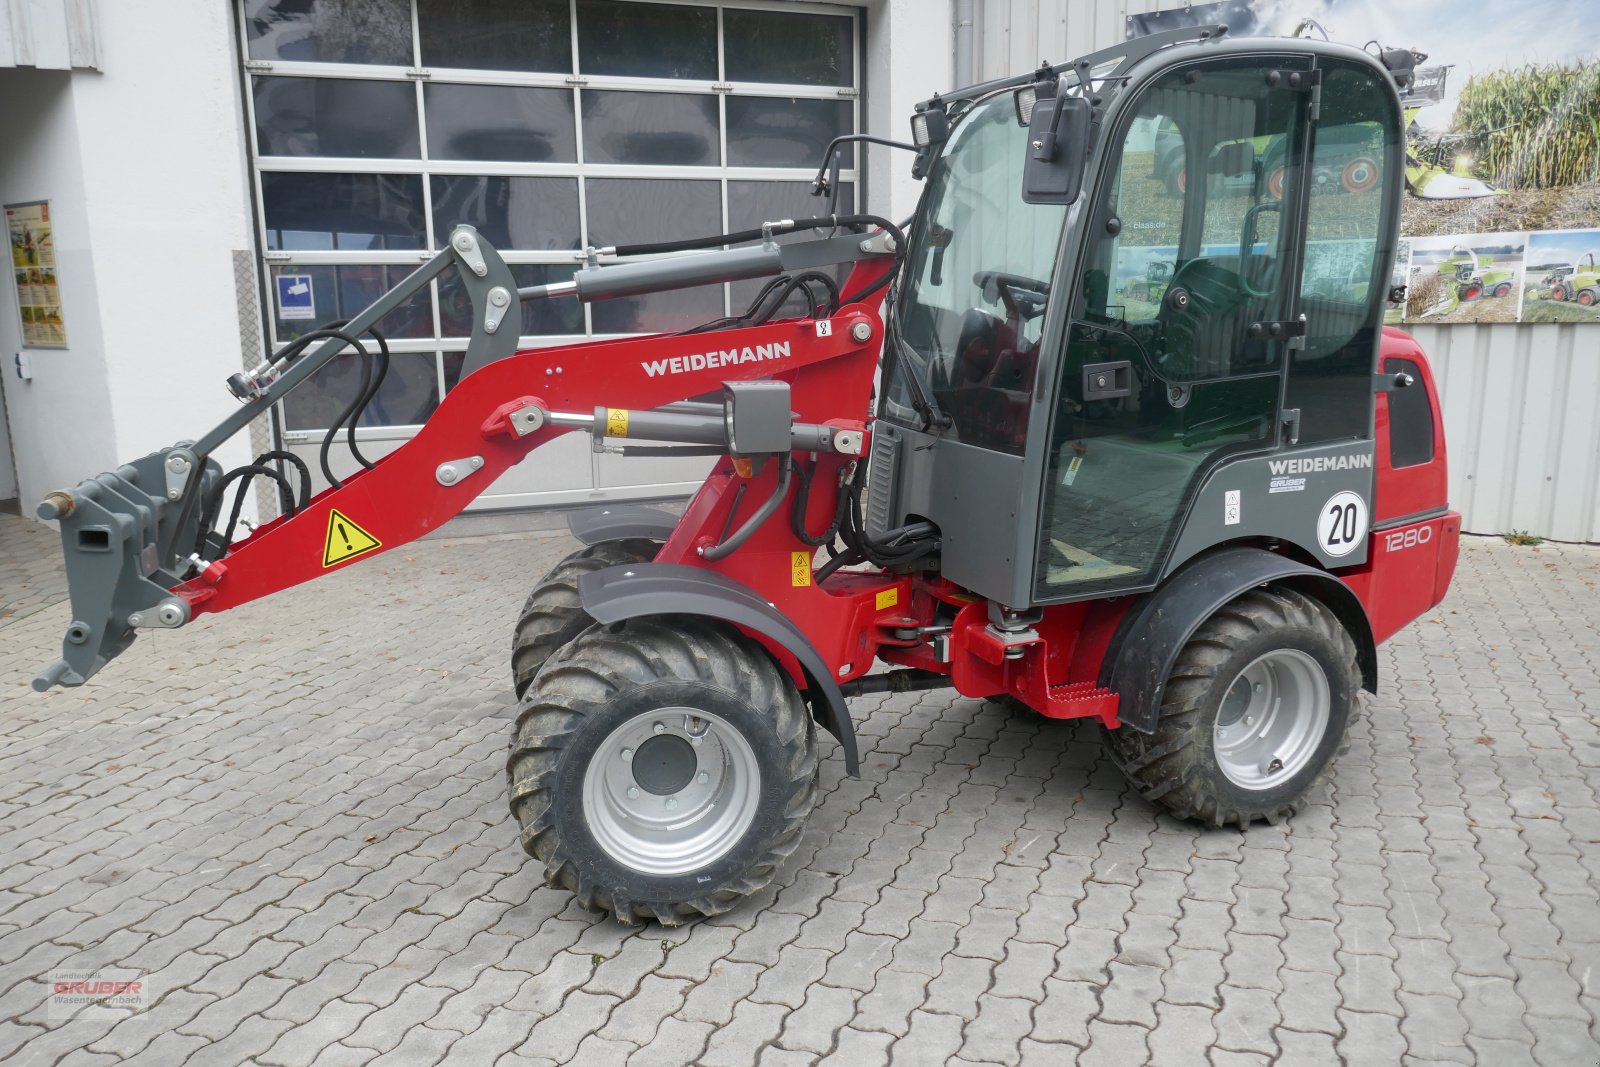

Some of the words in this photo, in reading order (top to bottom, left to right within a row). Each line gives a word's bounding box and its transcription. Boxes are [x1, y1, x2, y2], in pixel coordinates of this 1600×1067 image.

[641, 341, 791, 377] WEIDEMANN
[1268, 454, 1372, 475] WEIDEMANN
[1270, 478, 1306, 488] GRUBER
[1327, 502, 1357, 546] 20
[1385, 525, 1432, 553] 1280
